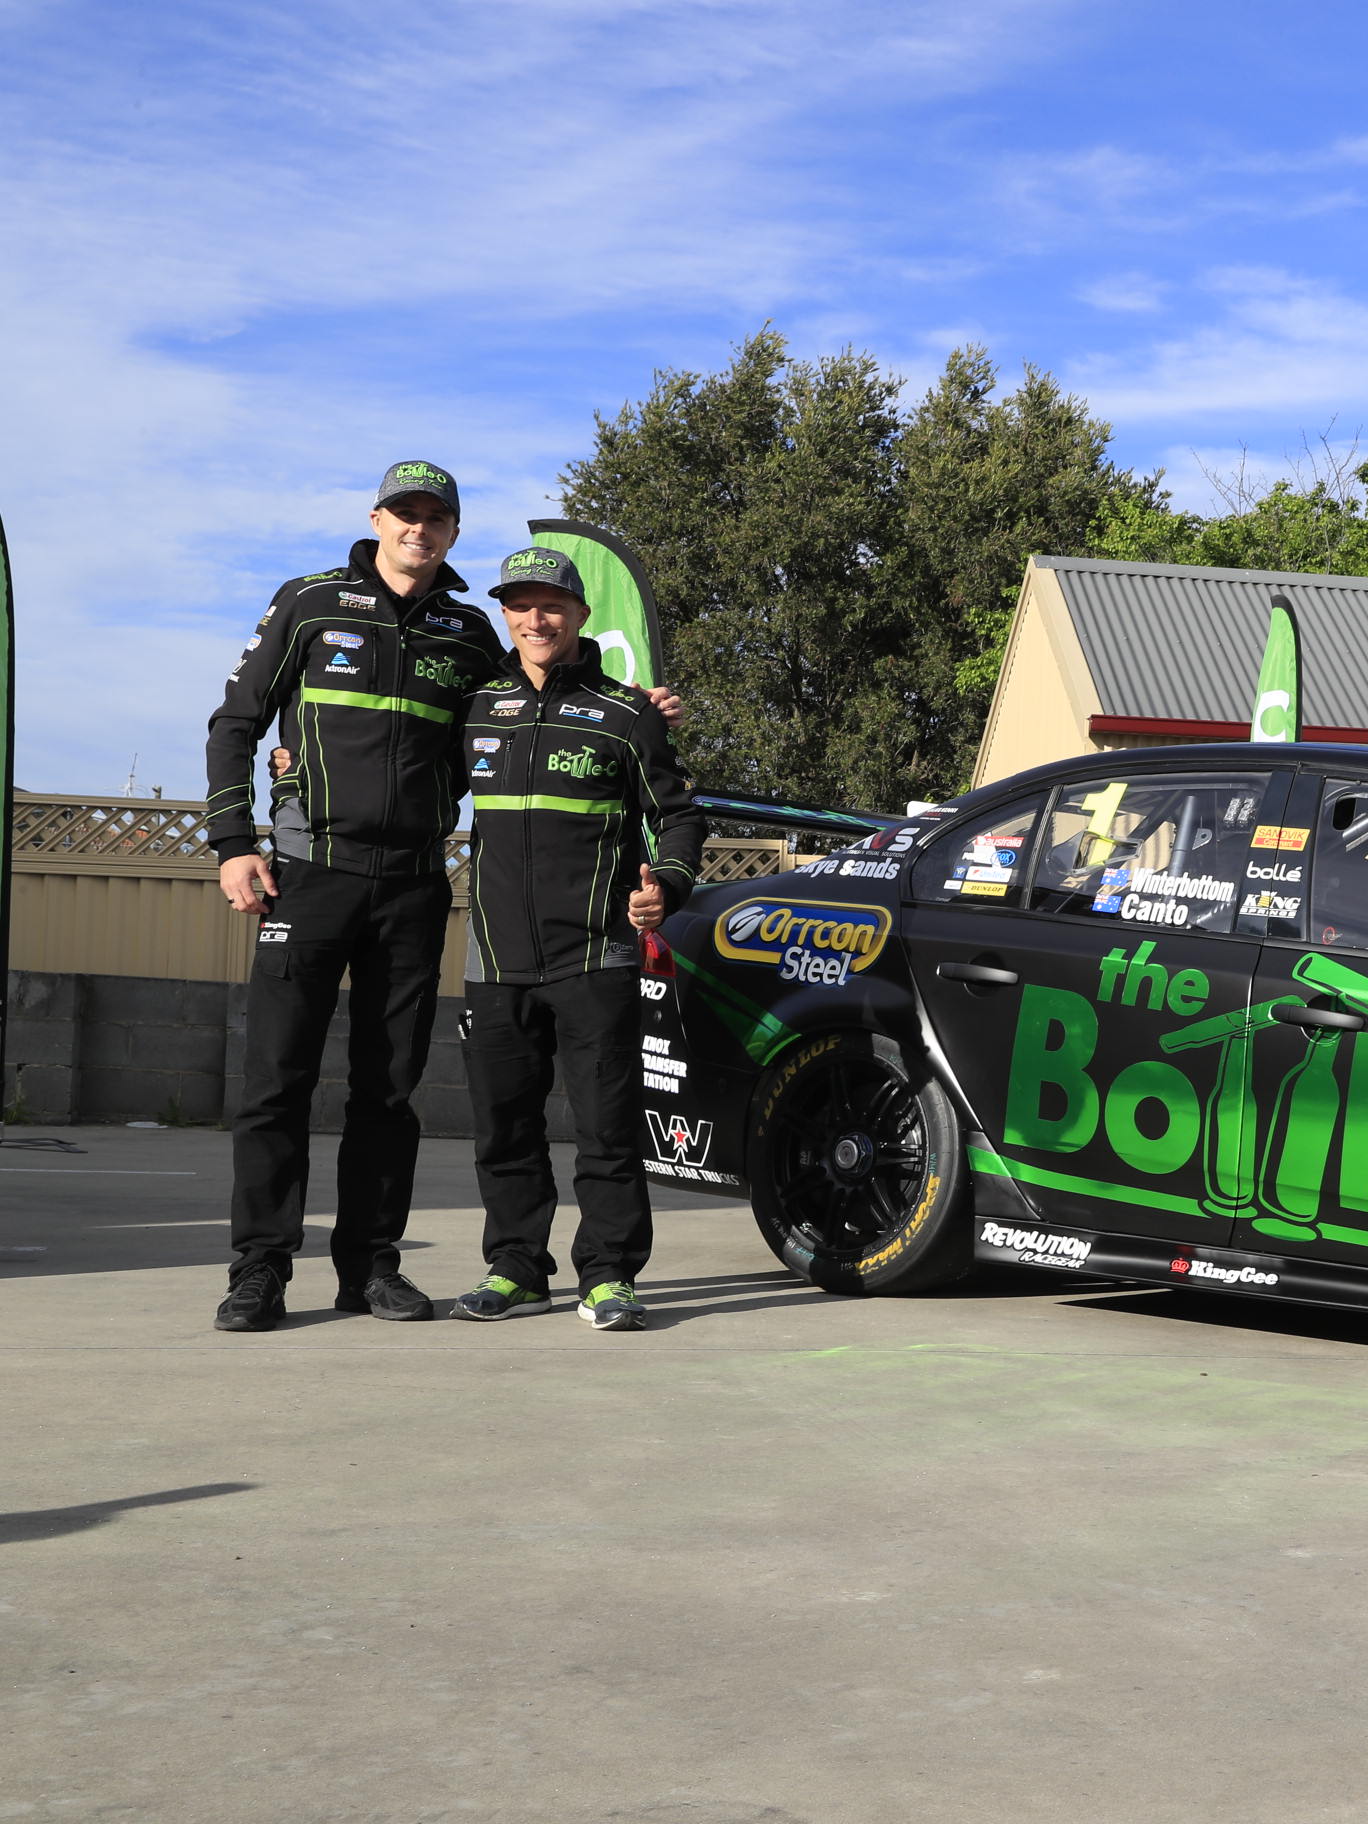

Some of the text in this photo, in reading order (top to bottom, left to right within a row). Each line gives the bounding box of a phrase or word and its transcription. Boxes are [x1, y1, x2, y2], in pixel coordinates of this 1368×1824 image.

[339, 600, 376, 611] EDGE
[489, 708, 521, 717] EDGE
[558, 749, 571, 757] the
[1081, 782, 1128, 866] 1
[1246, 860, 1303, 882] bollé
[1130, 867, 1235, 902] Winterbottom
[1121, 894, 1189, 926] Canto
[1242, 890, 1301, 910] KING
[760, 908, 876, 955] Orrcon
[780, 946, 852, 986] Steel
[1097, 941, 1209, 1017] the
[642, 1035, 671, 1055] KNOX
[643, 1071, 679, 1094] TATION
[643, 1159, 740, 1186] ESTERN STAR TRUCKS
[980, 1222, 1092, 1260] REVOLUTION
[1019, 1250, 1085, 1269] RACEGEAR
[1188, 1260, 1278, 1286] KingGee
